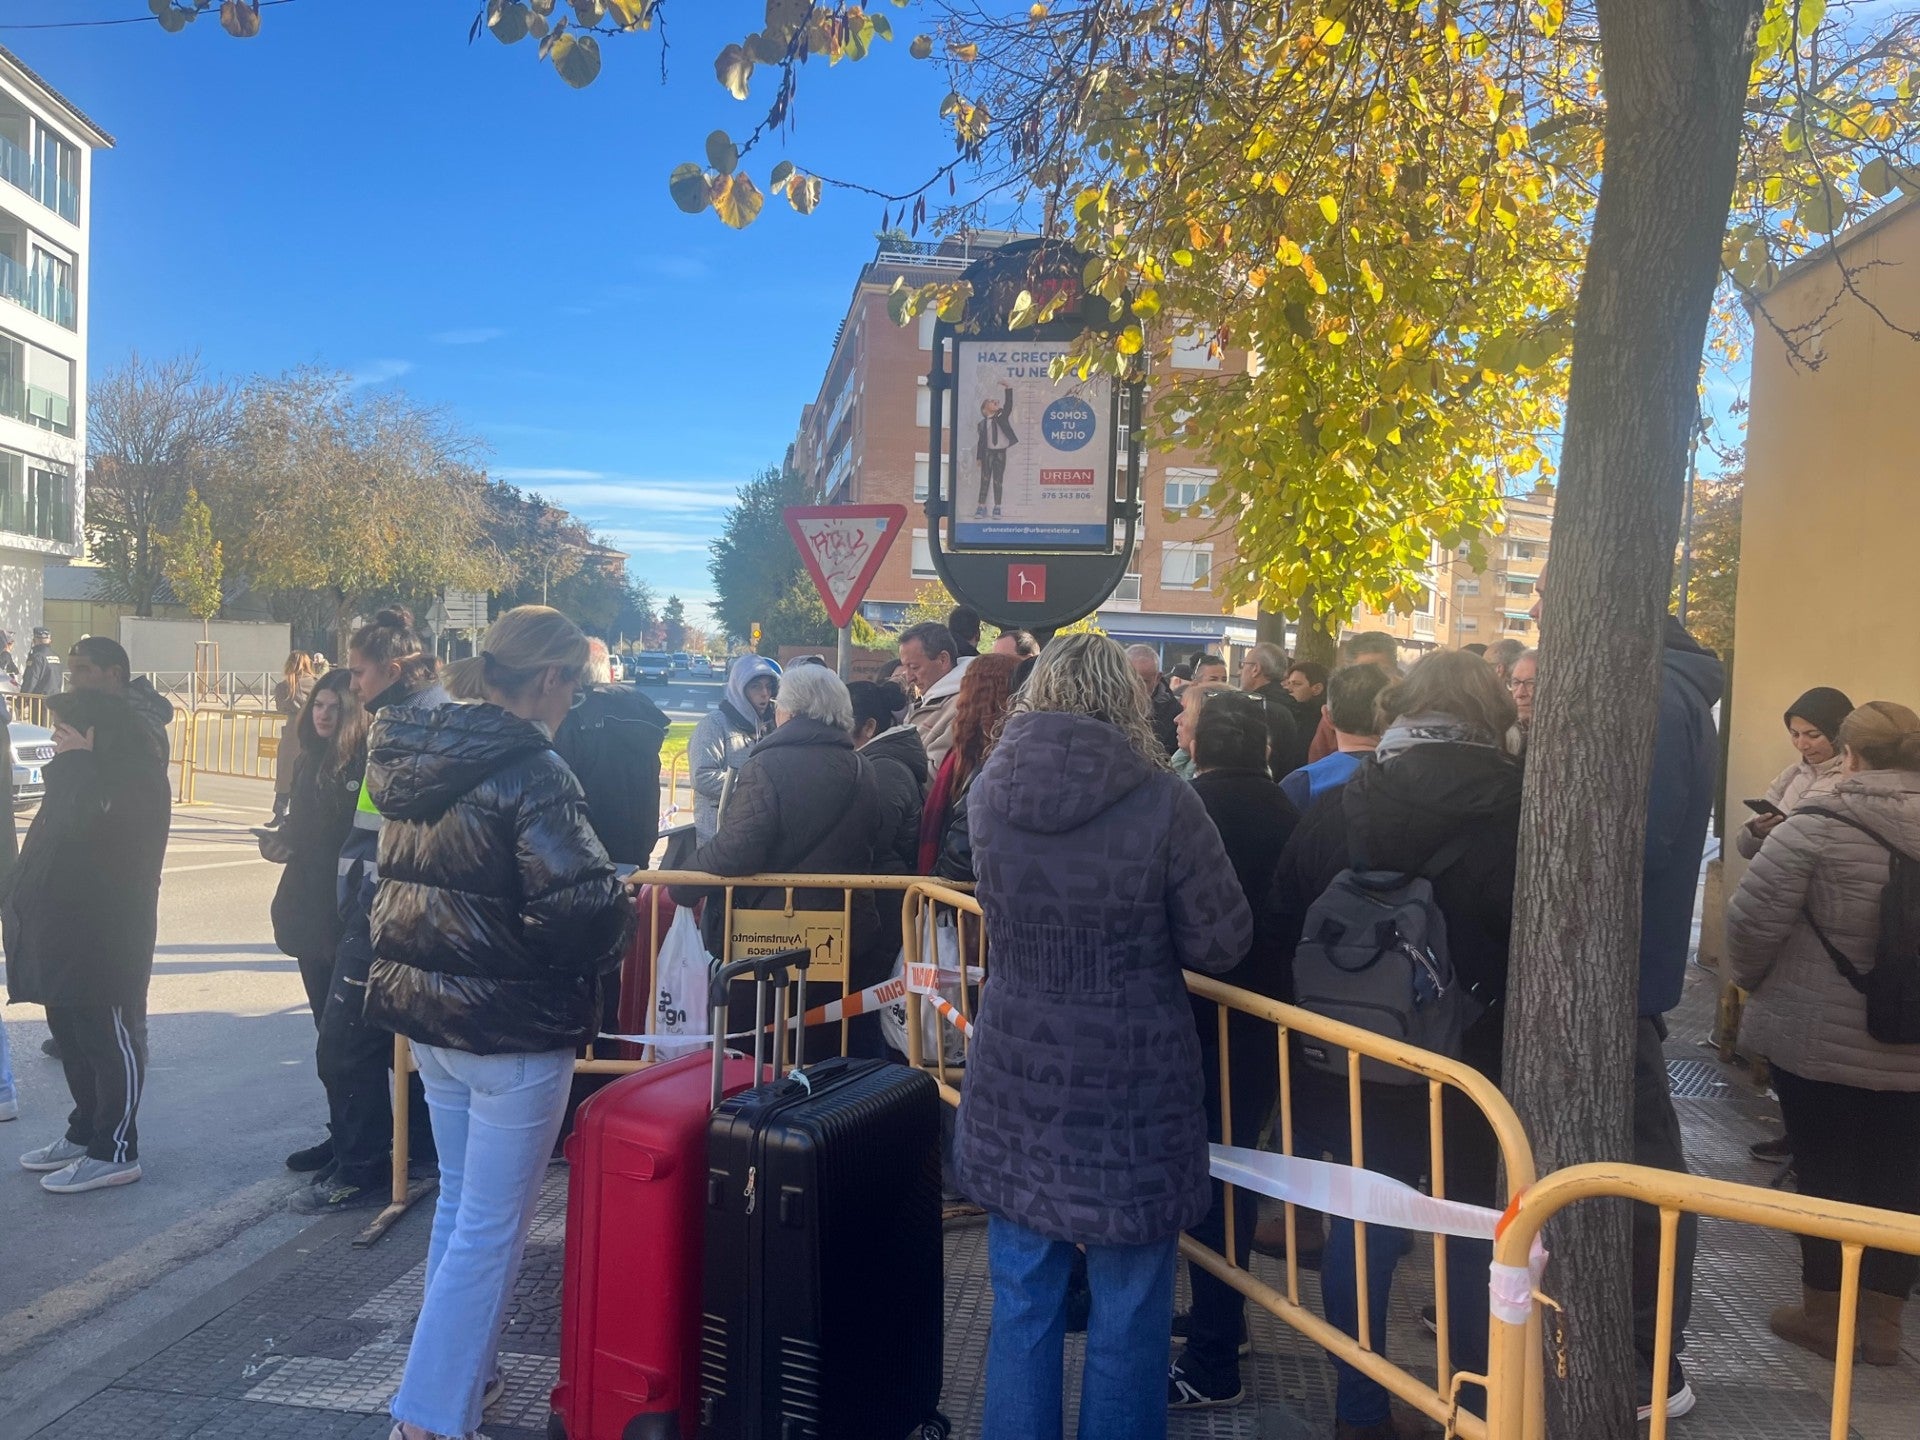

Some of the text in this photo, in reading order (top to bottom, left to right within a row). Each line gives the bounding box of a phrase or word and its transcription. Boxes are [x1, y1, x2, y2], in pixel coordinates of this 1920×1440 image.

[978, 352, 1007, 362] HAZ
[1007, 367, 1025, 378] TU
[1050, 411, 1088, 420] SOMOS
[1062, 421, 1076, 430] TU
[1051, 431, 1086, 440] MEDIO
[1043, 471, 1091, 480] URBAN
